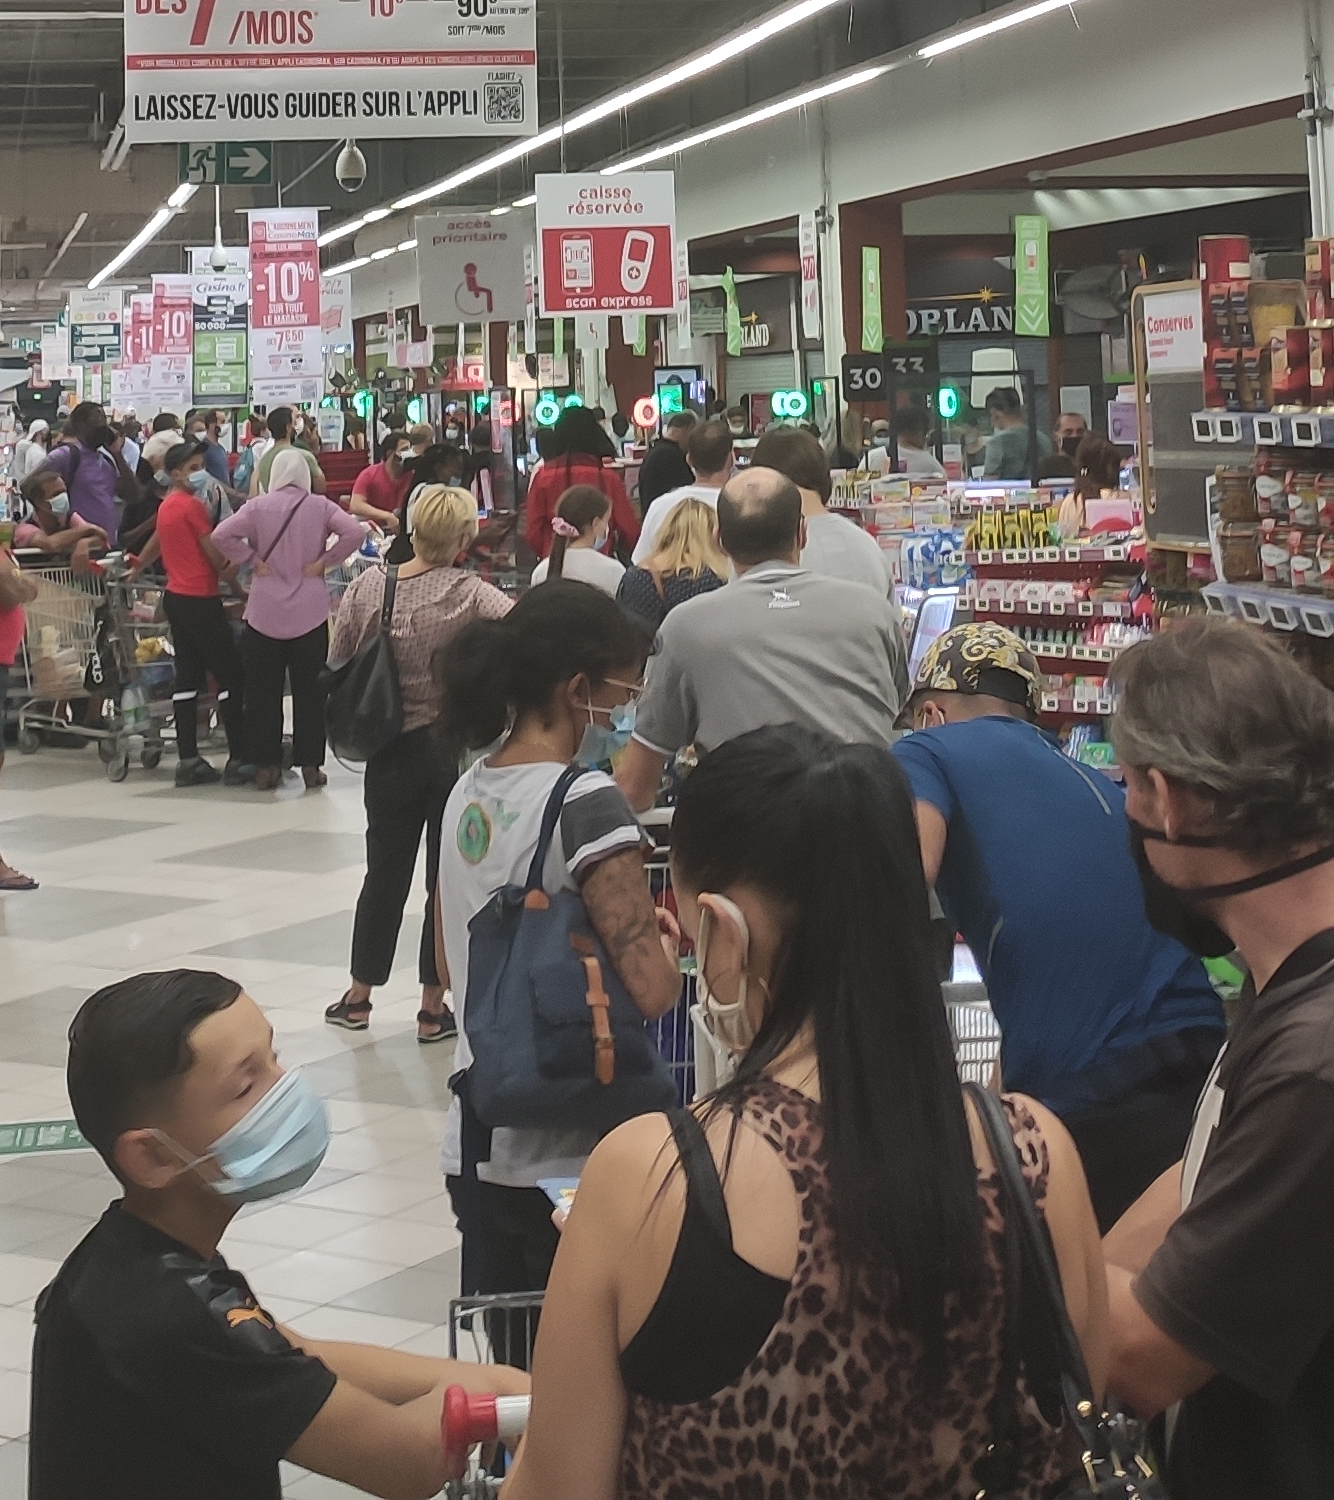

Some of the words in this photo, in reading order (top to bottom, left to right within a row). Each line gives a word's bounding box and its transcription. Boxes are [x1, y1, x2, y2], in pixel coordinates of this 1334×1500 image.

[447, 25, 465, 37] SOIT
[134, 92, 280, 122] LAISSEZ-VOUS
[284, 91, 357, 120] GUIDER
[362, 90, 402, 117] SUR
[406, 88, 479, 117] L'APPLI
[578, 184, 633, 201] caisse
[567, 197, 645, 215] réservée
[446, 219, 492, 231] accès
[432, 230, 508, 246] prioritaire
[255, 261, 315, 303] -10%
[565, 296, 598, 310] scan
[600, 294, 654, 310] express
[905, 305, 1013, 337] RLAN
[1147, 314, 1194, 335] Conserves
[849, 367, 882, 390] 30
